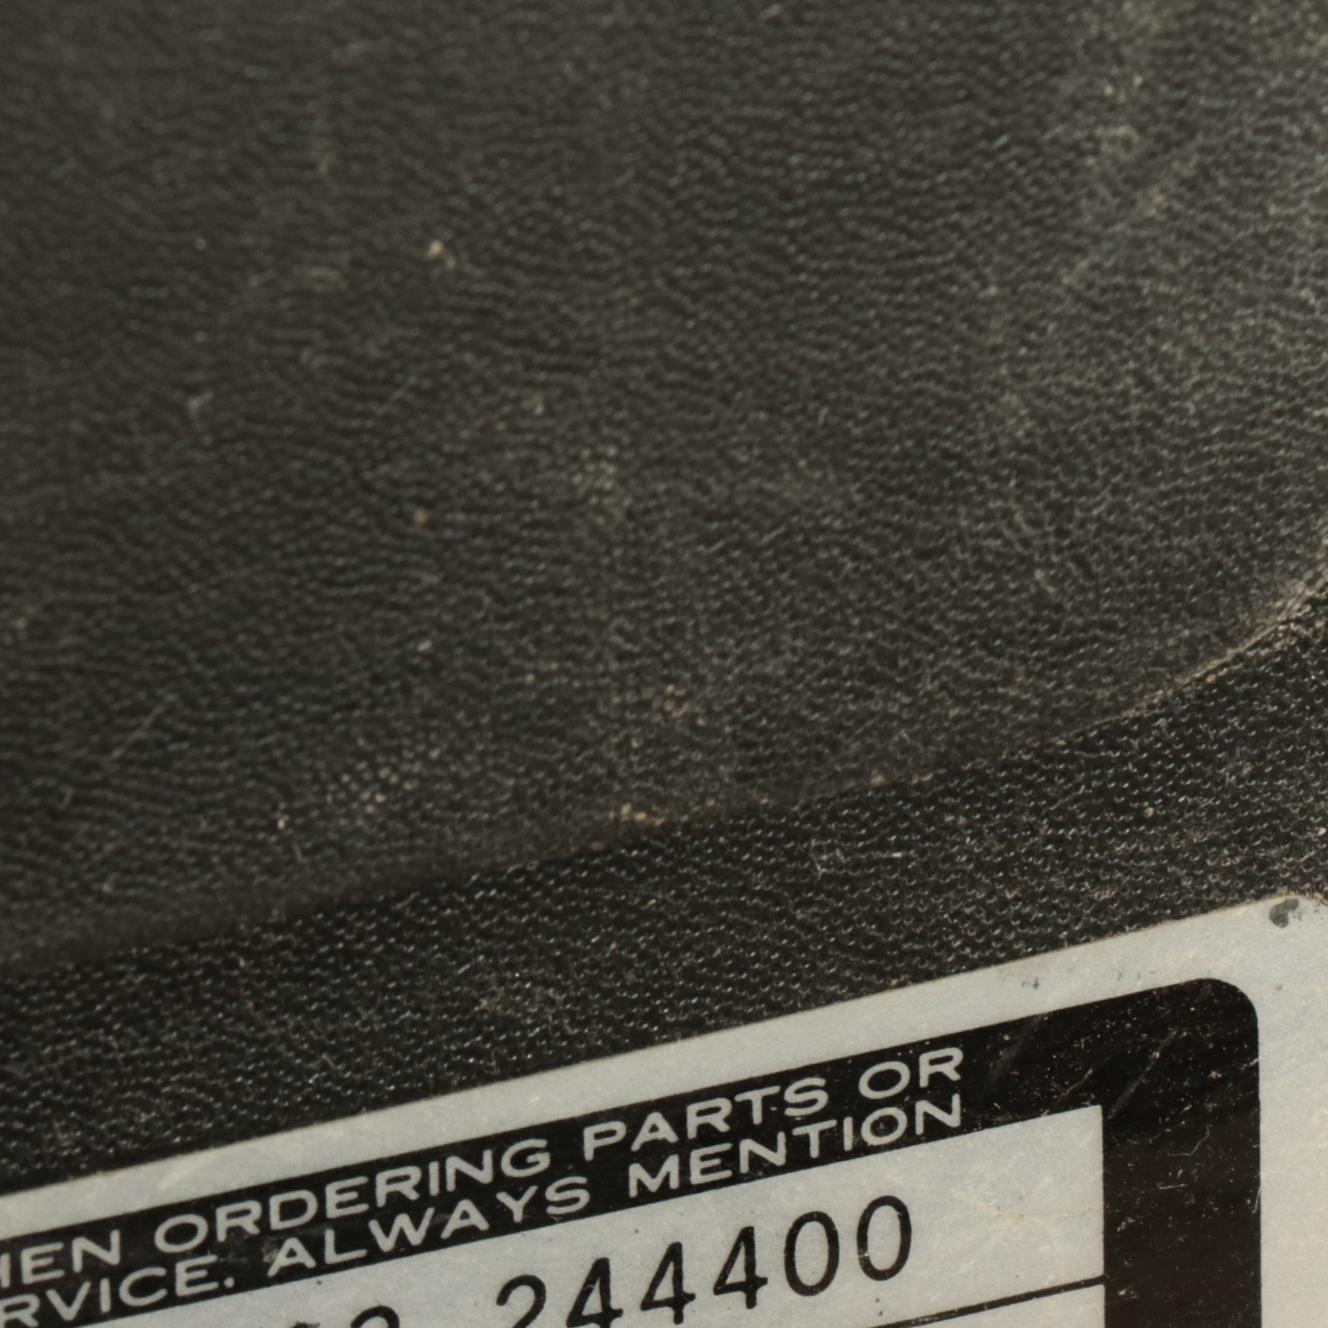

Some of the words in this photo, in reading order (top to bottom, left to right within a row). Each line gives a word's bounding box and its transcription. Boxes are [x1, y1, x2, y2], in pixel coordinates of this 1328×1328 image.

[154, 1137, 549, 1253] ORDERING
[583, 1077, 827, 1161] PARTS
[860, 1047, 962, 1098] OR
[269, 1177, 589, 1276] ALWAYS
[628, 1095, 960, 1197] MENTION
